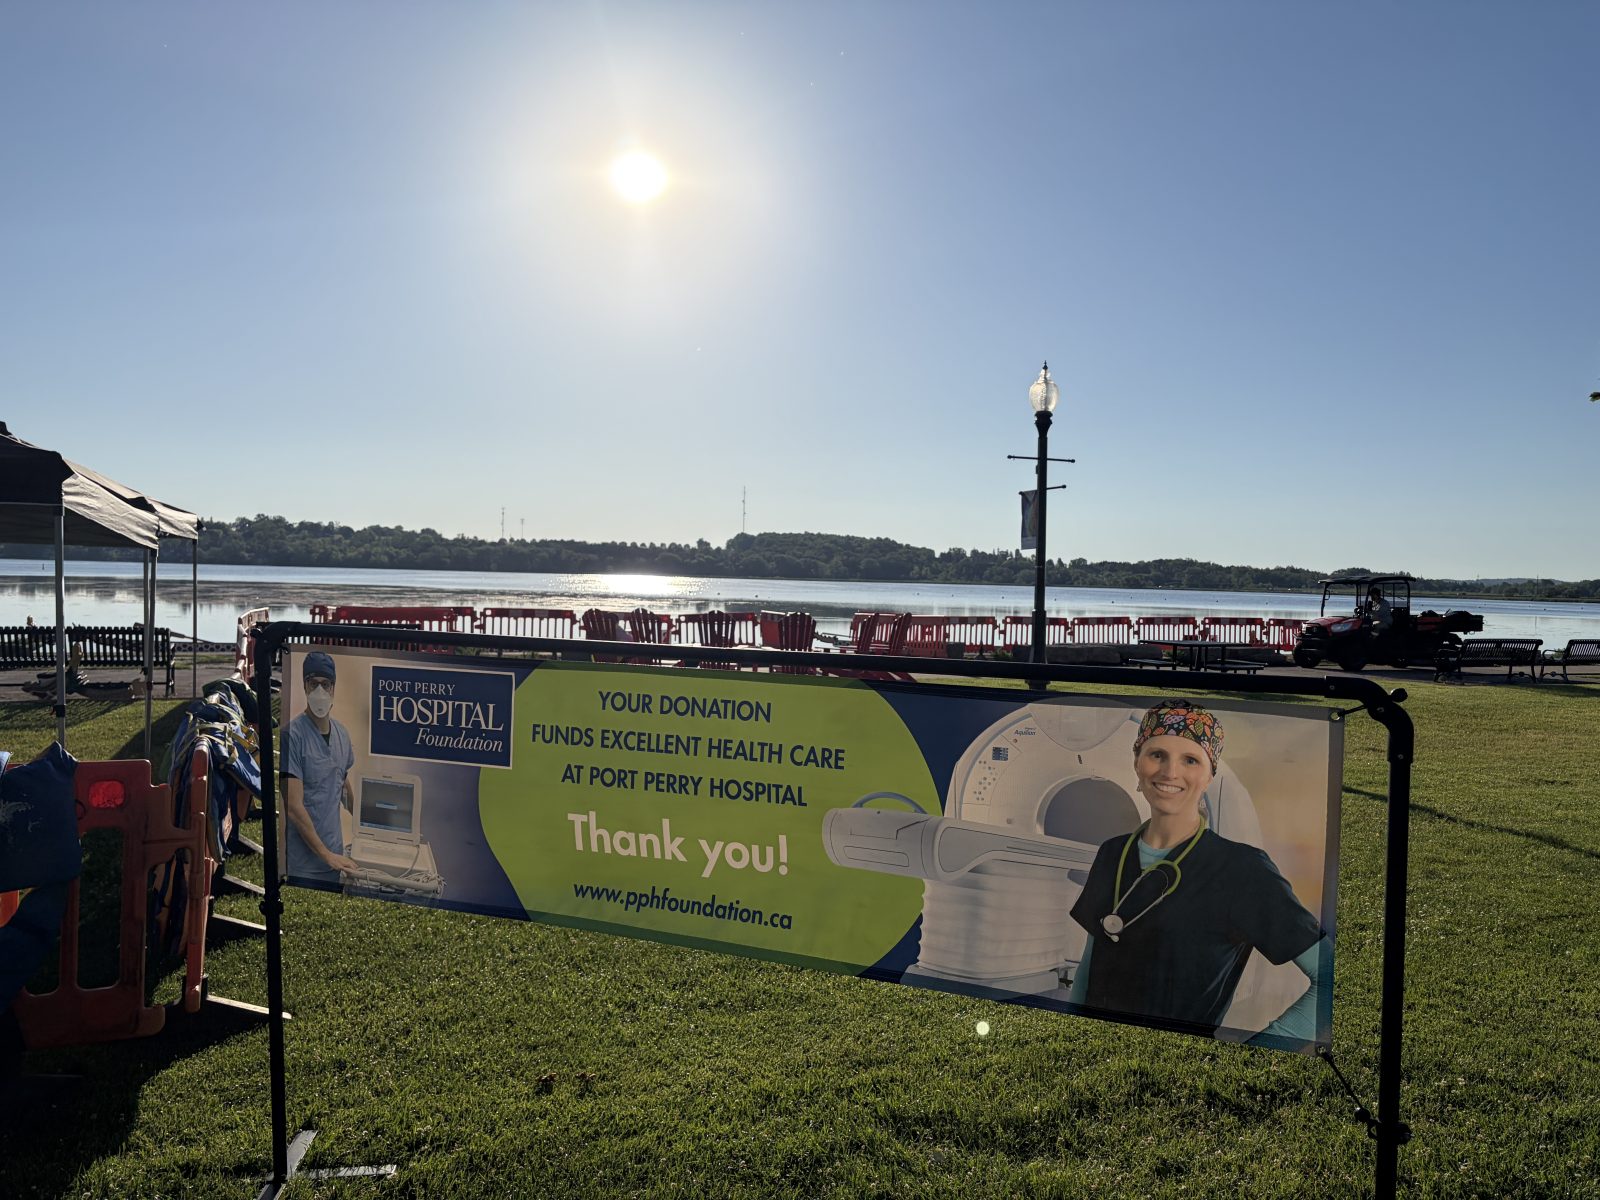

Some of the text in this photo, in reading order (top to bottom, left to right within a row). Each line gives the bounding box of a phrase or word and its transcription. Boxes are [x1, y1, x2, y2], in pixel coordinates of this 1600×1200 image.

[378, 679, 456, 696] PORT PERRY
[598, 690, 772, 723] YOUR DONATION
[378, 695, 504, 731] HOSPITAL
[414, 727, 503, 753] Foundation
[531, 723, 846, 770] FUNDS EXCELLENT HEALTH CARE
[561, 763, 808, 807] AT PORT PERRY HOSPITAL
[567, 810, 788, 878] Thank you!
[573, 883, 793, 930] www.pphfoundation.ca
